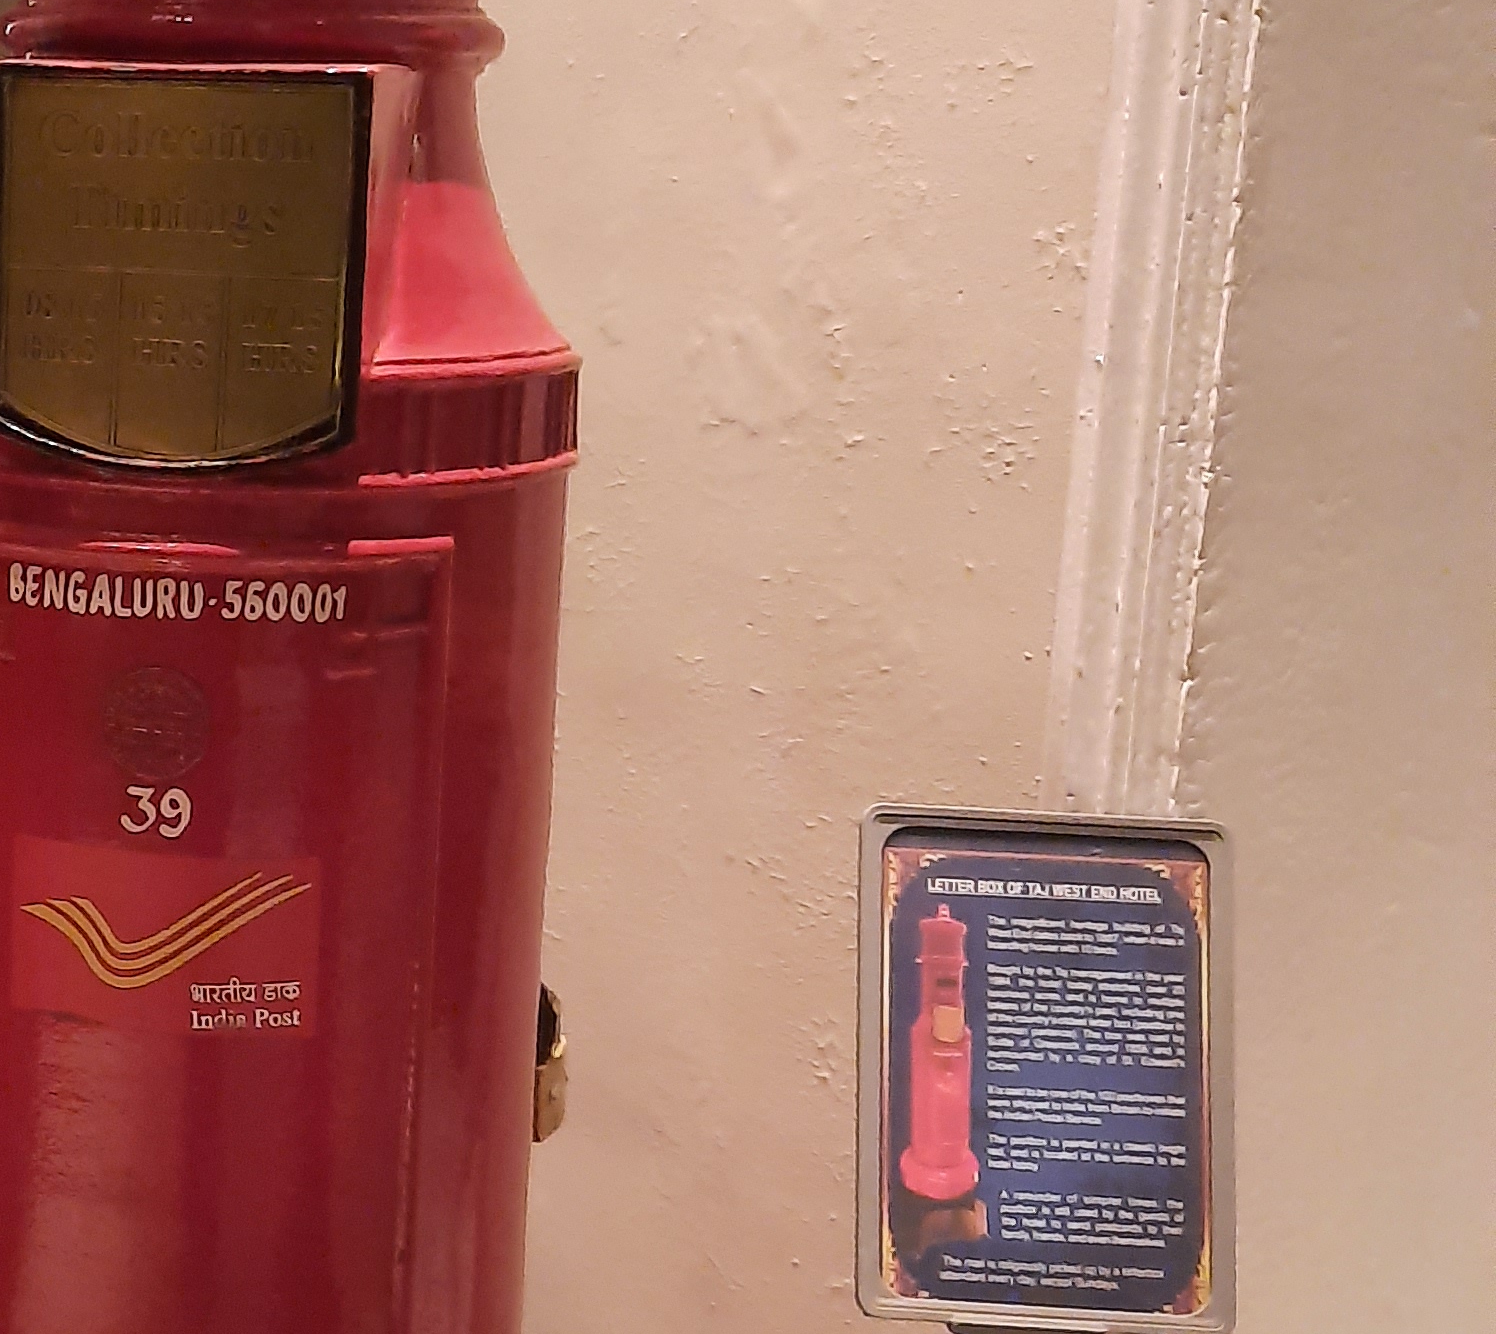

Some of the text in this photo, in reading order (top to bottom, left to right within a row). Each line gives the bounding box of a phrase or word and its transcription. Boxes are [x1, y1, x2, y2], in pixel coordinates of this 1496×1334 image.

[40, 109, 314, 163] Collection
[120, 785, 192, 838] 39
[927, 877, 1162, 903] LETTER BOX OF TAJ WEST END HOTEL
[189, 977, 301, 1003] भारतीय डाक
[190, 1008, 301, 1029] India Post
